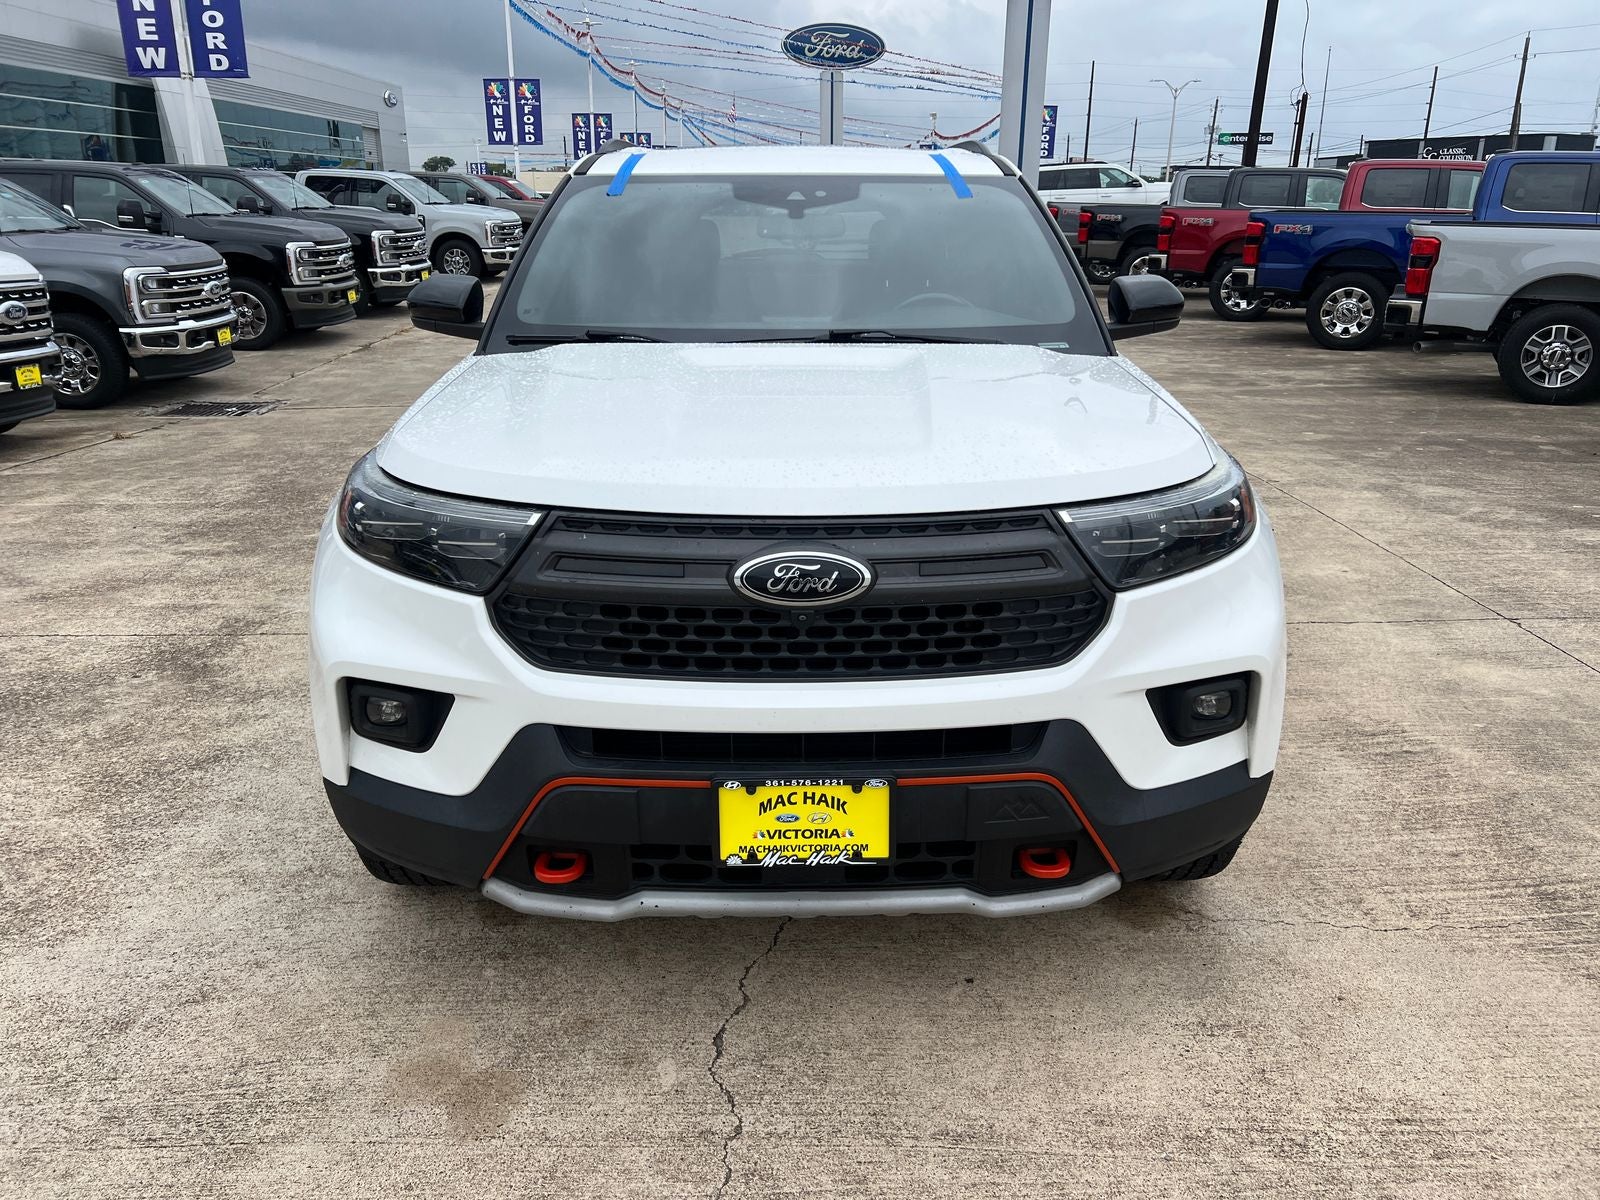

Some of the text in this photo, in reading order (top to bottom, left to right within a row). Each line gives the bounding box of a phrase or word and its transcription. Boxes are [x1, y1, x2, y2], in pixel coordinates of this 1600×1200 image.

[202, 0, 229, 71] ORD
[804, 31, 865, 58] Ford
[492, 105, 507, 141] NEW
[523, 105, 535, 142] FORD
[1040, 126, 1050, 156] FORD
[1220, 134, 1272, 142] enterise
[1273, 224, 1313, 234] FX4
[767, 563, 839, 593] Ford
[765, 779, 844, 787] 361-576-1221
[758, 791, 848, 817] MAC HAIK
[766, 828, 841, 840] VICTORIA
[738, 843, 869, 854] MACHAIKVICTORIACOM
[760, 850, 851, 868] Mac Haik
